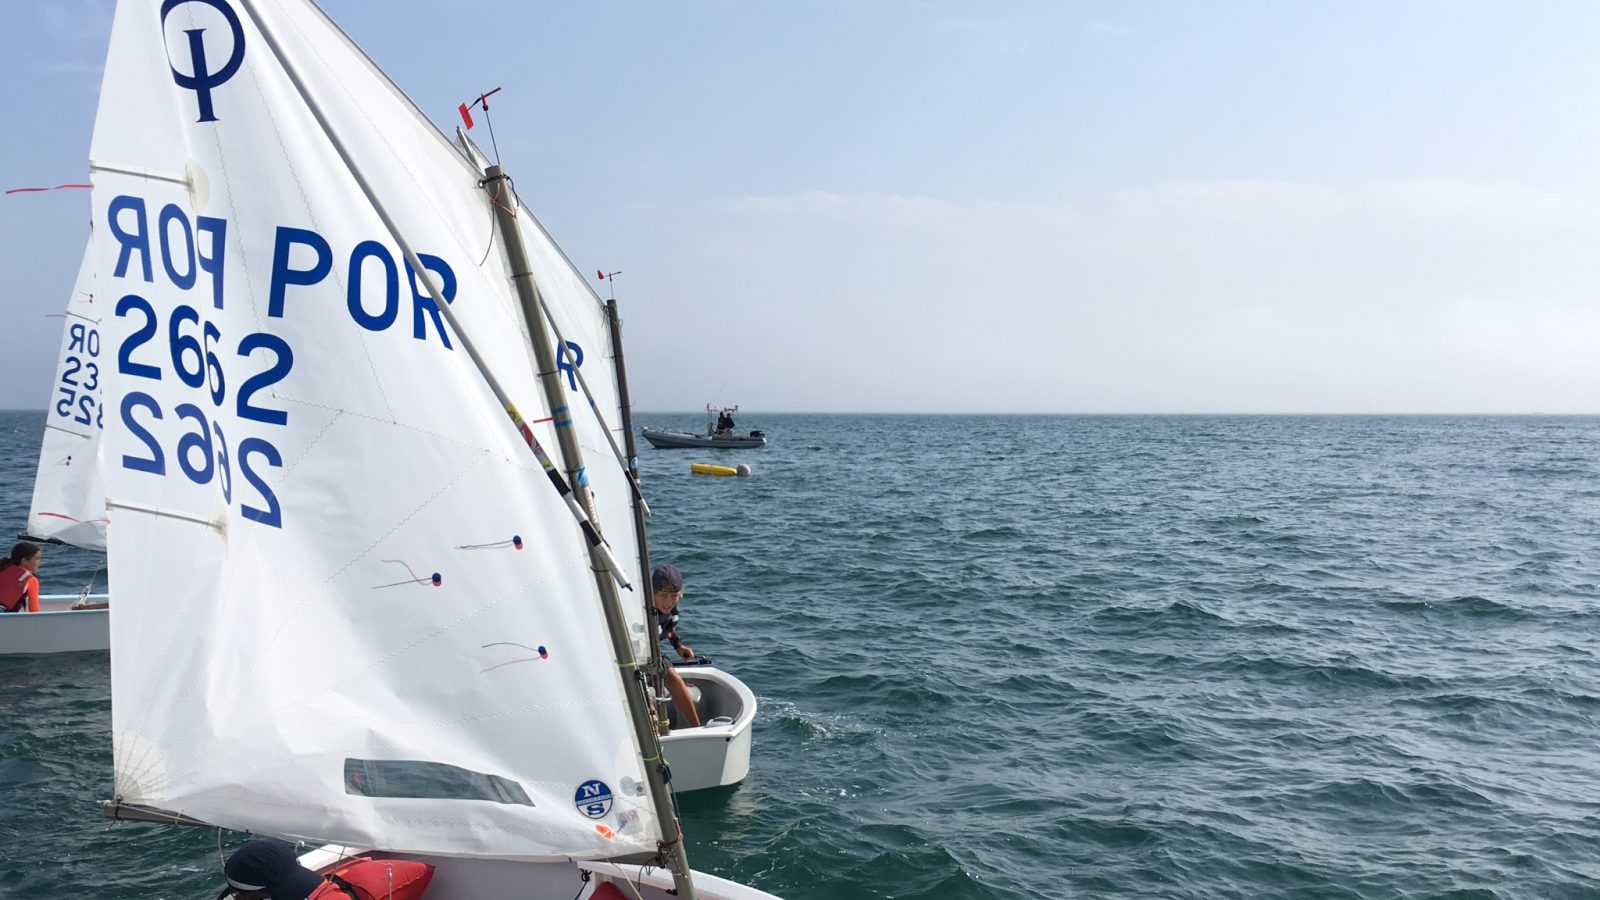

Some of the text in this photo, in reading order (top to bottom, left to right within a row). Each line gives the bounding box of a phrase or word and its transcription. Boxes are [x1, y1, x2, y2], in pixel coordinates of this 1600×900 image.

[267, 225, 458, 351] POR
[61, 356, 102, 396] 23
[114, 294, 294, 426] 2662
[556, 339, 584, 392] R
[581, 783, 601, 798] N
[586, 803, 606, 817] S
